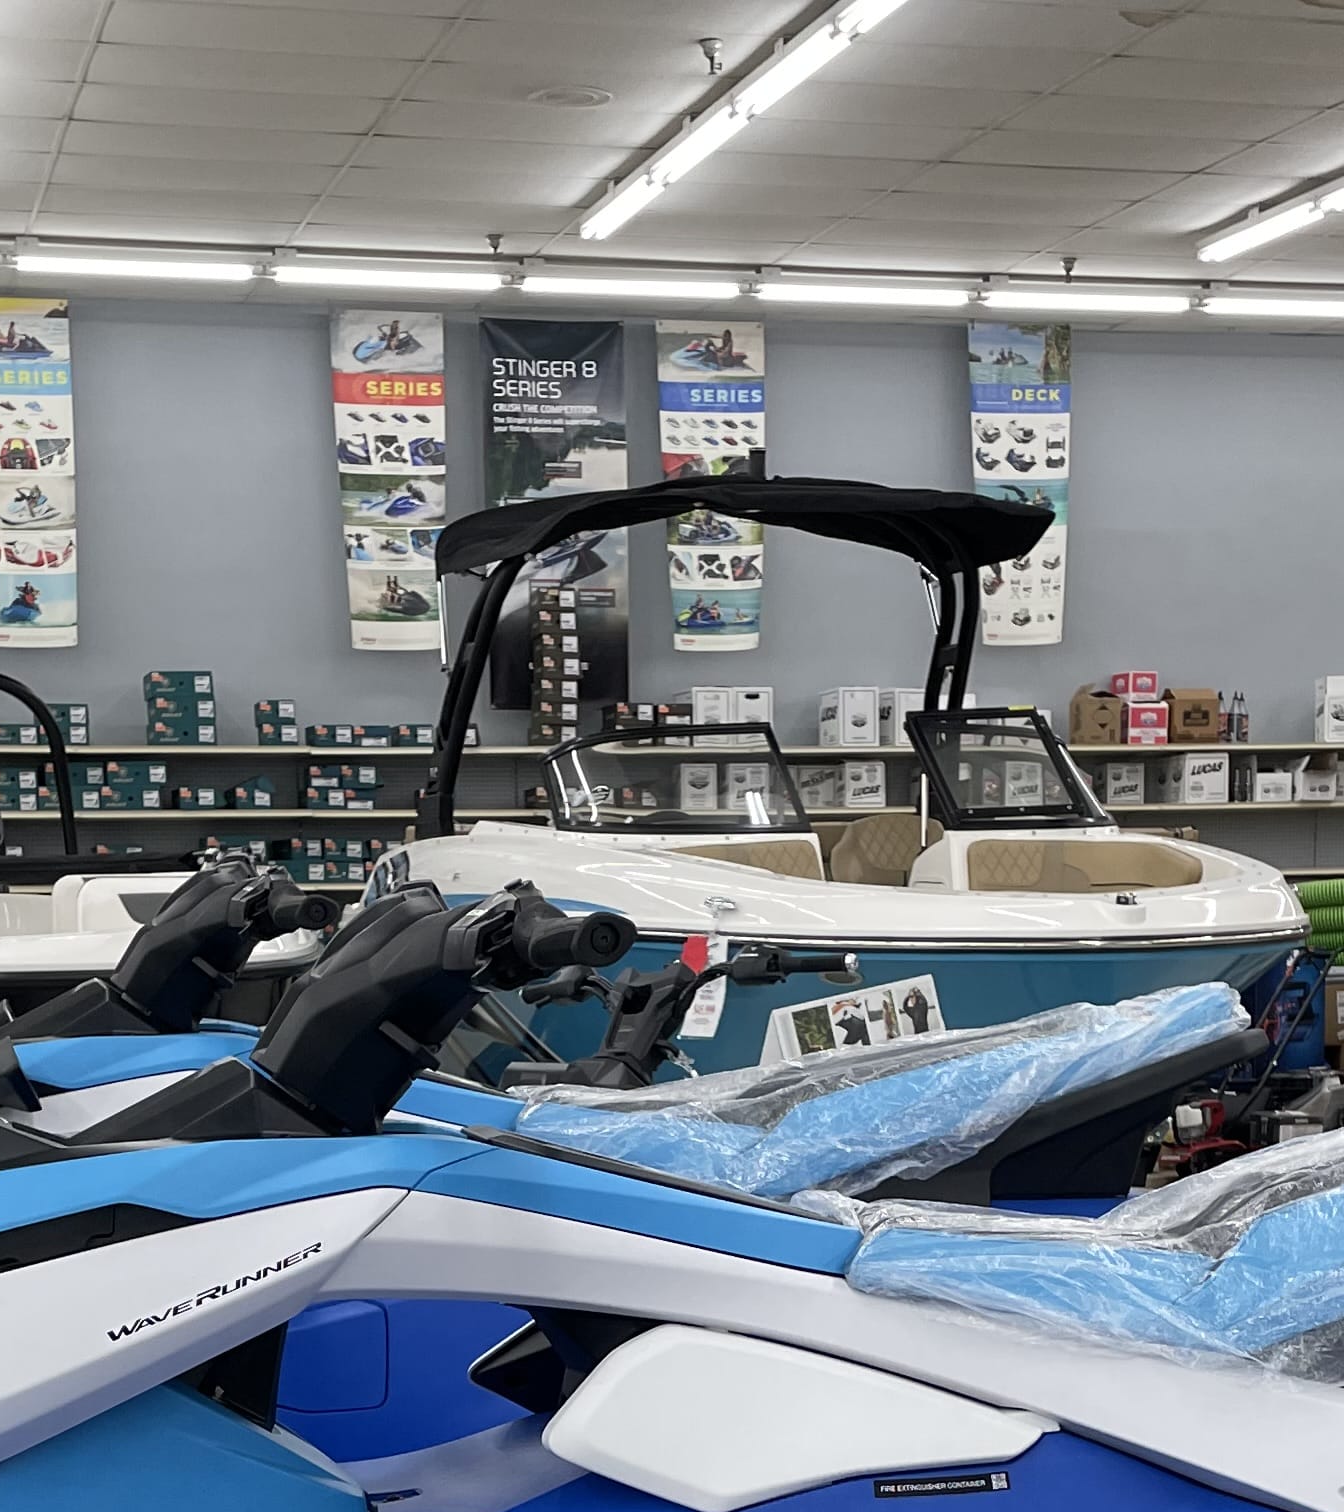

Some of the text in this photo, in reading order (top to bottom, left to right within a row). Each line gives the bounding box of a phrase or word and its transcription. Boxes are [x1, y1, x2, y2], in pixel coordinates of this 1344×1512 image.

[492, 357, 598, 379] STINGER 8
[365, 379, 442, 398] SERIES
[492, 379, 562, 399] SERIES
[689, 388, 763, 403] SERIES
[1011, 389, 1061, 402] DECK
[1191, 761, 1224, 776] LUCAS
[852, 785, 881, 797] LUCAS
[1113, 783, 1139, 796] LUCAS
[106, 1240, 325, 1344] WAVERUNNER
[880, 1480, 986, 1493] FIRE EXTINGUISHER CONTAINER
